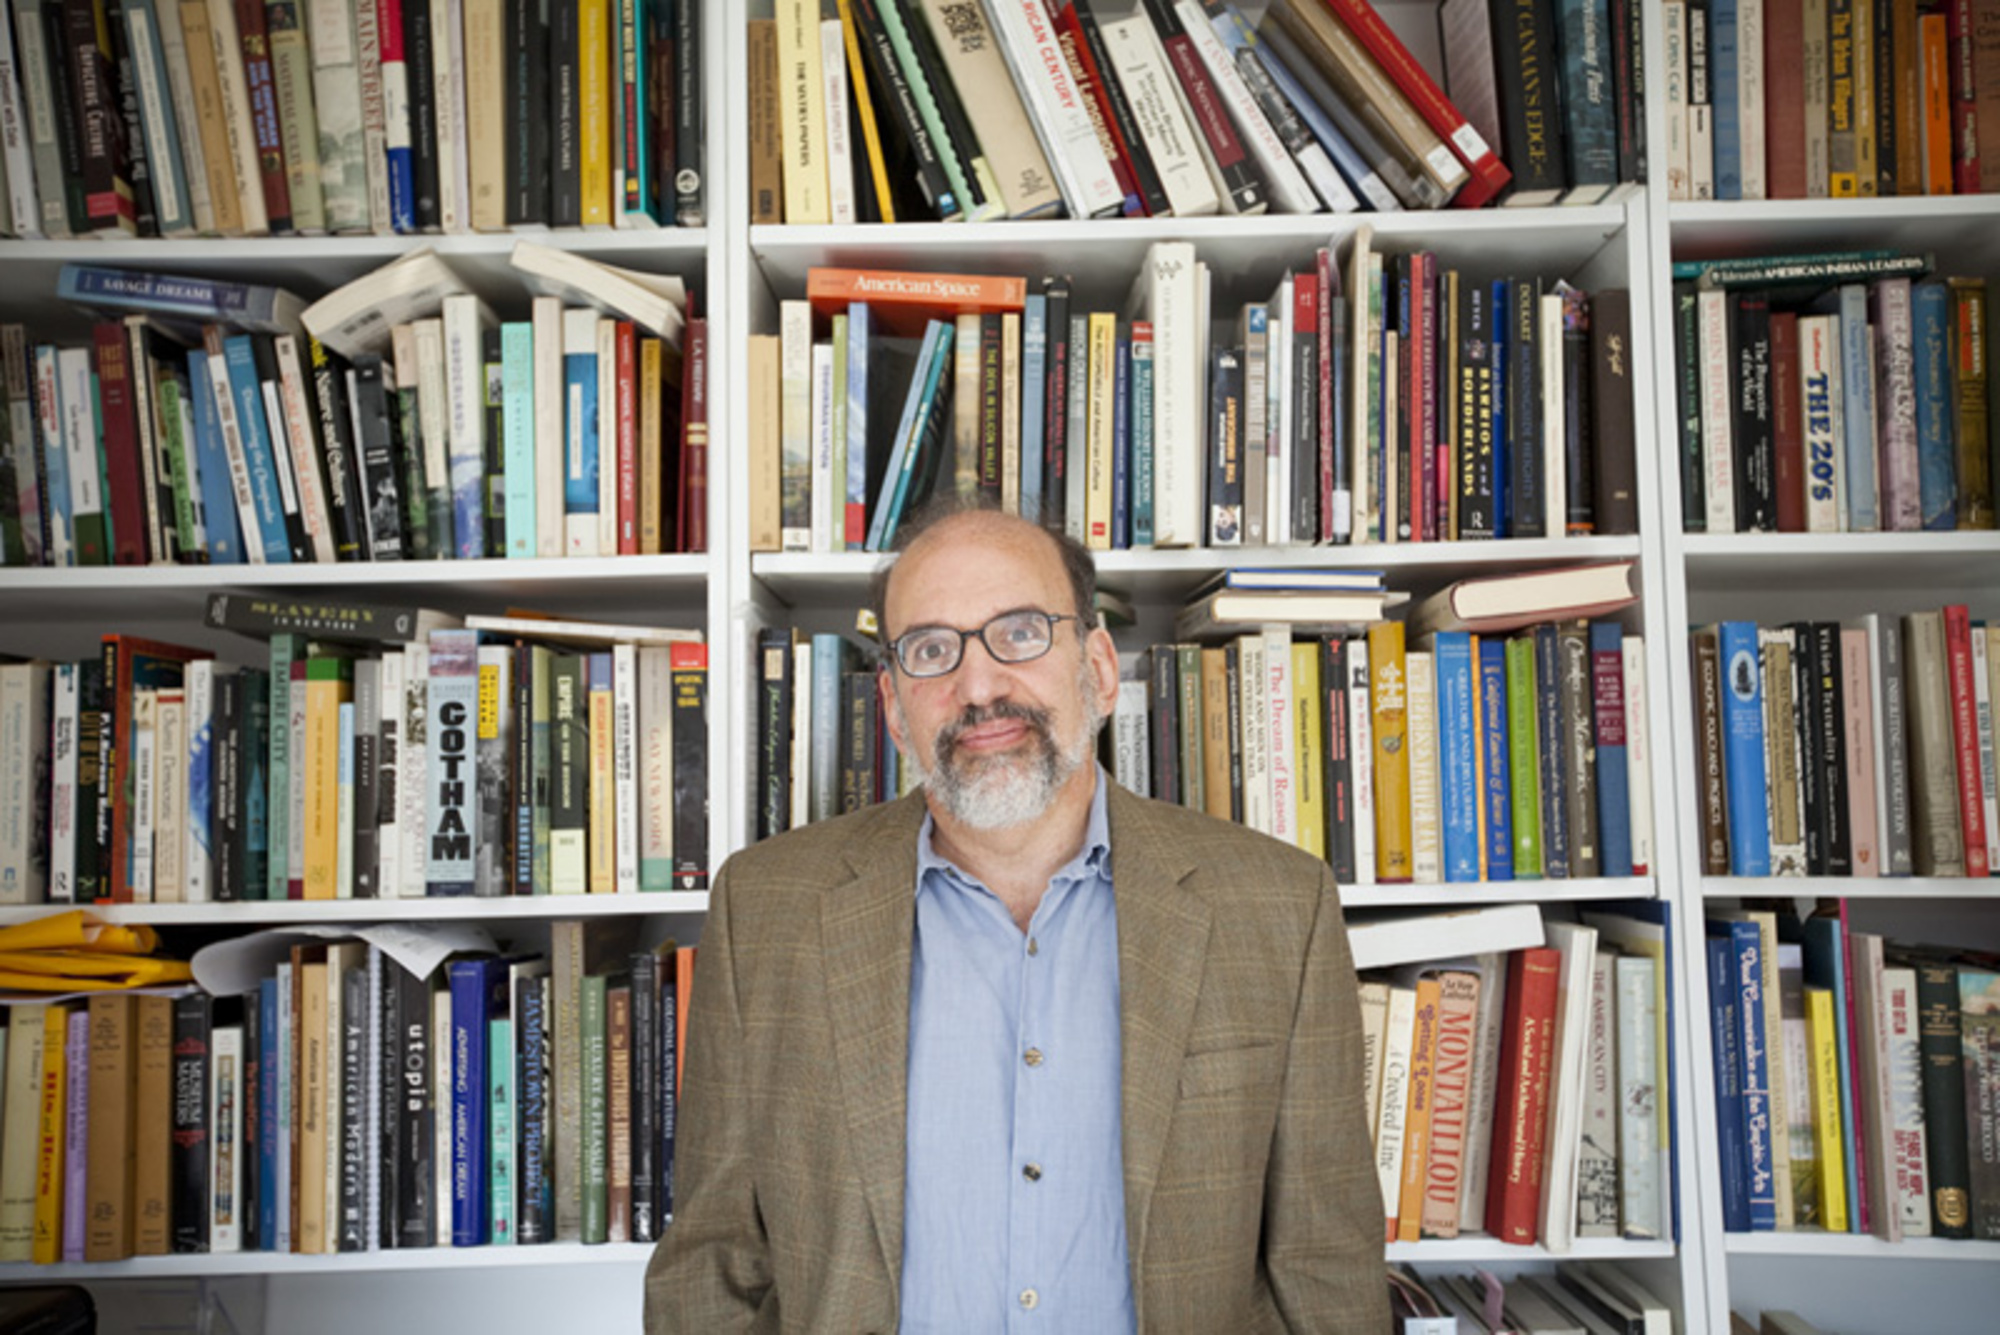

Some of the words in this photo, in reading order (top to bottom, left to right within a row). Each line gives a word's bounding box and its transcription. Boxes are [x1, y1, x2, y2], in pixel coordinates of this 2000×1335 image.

[358, 0, 376, 53] MAIN
[1667, 7, 1679, 30] THE
[1833, 12, 1851, 35] The
[1059, 31, 1086, 80] Visual
[1518, 13, 1541, 106] CANAAN'S
[1669, 35, 1681, 68] OPEN
[1833, 38, 1851, 75] Urban
[278, 52, 296, 118] MATERIAL
[362, 60, 383, 132] STREET
[1041, 47, 1075, 109] CENTURY
[1669, 72, 1681, 102] CAGE
[1831, 78, 1852, 131] Villagers
[286, 125, 304, 186] CULTURE
[560, 122, 571, 170] CULTURES
[1525, 111, 1546, 163] EDGE
[102, 278, 151, 294] SAVAGE
[156, 282, 212, 301] DREAMS
[854, 275, 933, 295] American
[934, 280, 980, 298] Space
[1765, 265, 1824, 279] AMERICAN
[1827, 263, 1867, 276] INDIAN
[1870, 257, 1924, 272] LEADERS
[984, 348, 996, 366] THE
[1742, 349, 1753, 361] of
[1742, 362, 1753, 376] the
[1754, 340, 1767, 361] The
[313, 371, 332, 421] Nature
[984, 368, 996, 393] DEVIL
[984, 395, 996, 405] IN
[1742, 376, 1755, 412] World
[1806, 373, 1831, 434] THE
[321, 423, 339, 449] and
[984, 407, 996, 443] SILICON
[1463, 367, 1474, 496] BORDERLANDS
[1479, 367, 1490, 456] BARRIOS
[325, 450, 349, 508] Culture
[984, 446, 996, 480] VALLEY
[1480, 464, 1490, 496] and
[1254, 651, 1264, 696] WOMEN
[1819, 628, 1833, 675] Vision
[274, 661, 287, 718] EMPIRE
[557, 676, 574, 720] EMPIRE
[1269, 664, 1284, 694] The
[1485, 677, 1500, 729] California
[1703, 660, 1715, 713] ECONOMIC
[1244, 679, 1255, 743] OVERLAND
[1255, 700, 1265, 723] AND
[1271, 698, 1286, 752] Dream
[1821, 691, 1836, 761] Textuality
[273, 724, 287, 764] CITY
[649, 728, 661, 762] GAY
[1133, 713, 1145, 793] Mechanization
[1255, 726, 1265, 753] MEN
[432, 701, 471, 861] GOTHAM
[1274, 757, 1287, 775] of
[1275, 779, 1289, 835] Reason
[1708, 778, 1722, 825] PROJECTS
[518, 806, 531, 883] MANHATTAN
[650, 803, 663, 851] YORK
[1593, 971, 1605, 995] THE
[665, 996, 675, 1051] COLONIAL
[1417, 1004, 1436, 1064] Getting
[1594, 997, 1605, 1064] AMERICAN
[309, 1038, 319, 1083] American
[346, 1024, 361, 1116] American
[404, 1024, 426, 1111] utopia
[456, 1026, 468, 1093] ADVERTISING
[524, 994, 538, 1116] JAMESTOWN
[591, 1036, 603, 1092] LUXURY
[665, 1054, 675, 1087] DUTCH
[1594, 1065, 1606, 1094] CITY
[177, 1061, 189, 1127] MASTERS
[190, 1059, 202, 1123] MUSEUM
[591, 1095, 603, 1109] &
[665, 1089, 675, 1139] STUDIES
[1382, 1061, 1406, 1130] Crooked
[1426, 1009, 1472, 1204] MONTAILLOU
[456, 1103, 468, 1159] AMERICAN
[591, 1111, 603, 1185] PLEASURE
[1380, 1134, 1397, 1171] Line
[1980, 1114, 1994, 1163] MEXICO
[345, 1123, 361, 1196] Modern
[456, 1161, 468, 1201] DREAM
[526, 1121, 541, 1209] PROJECT
[1509, 1147, 1524, 1184] History
